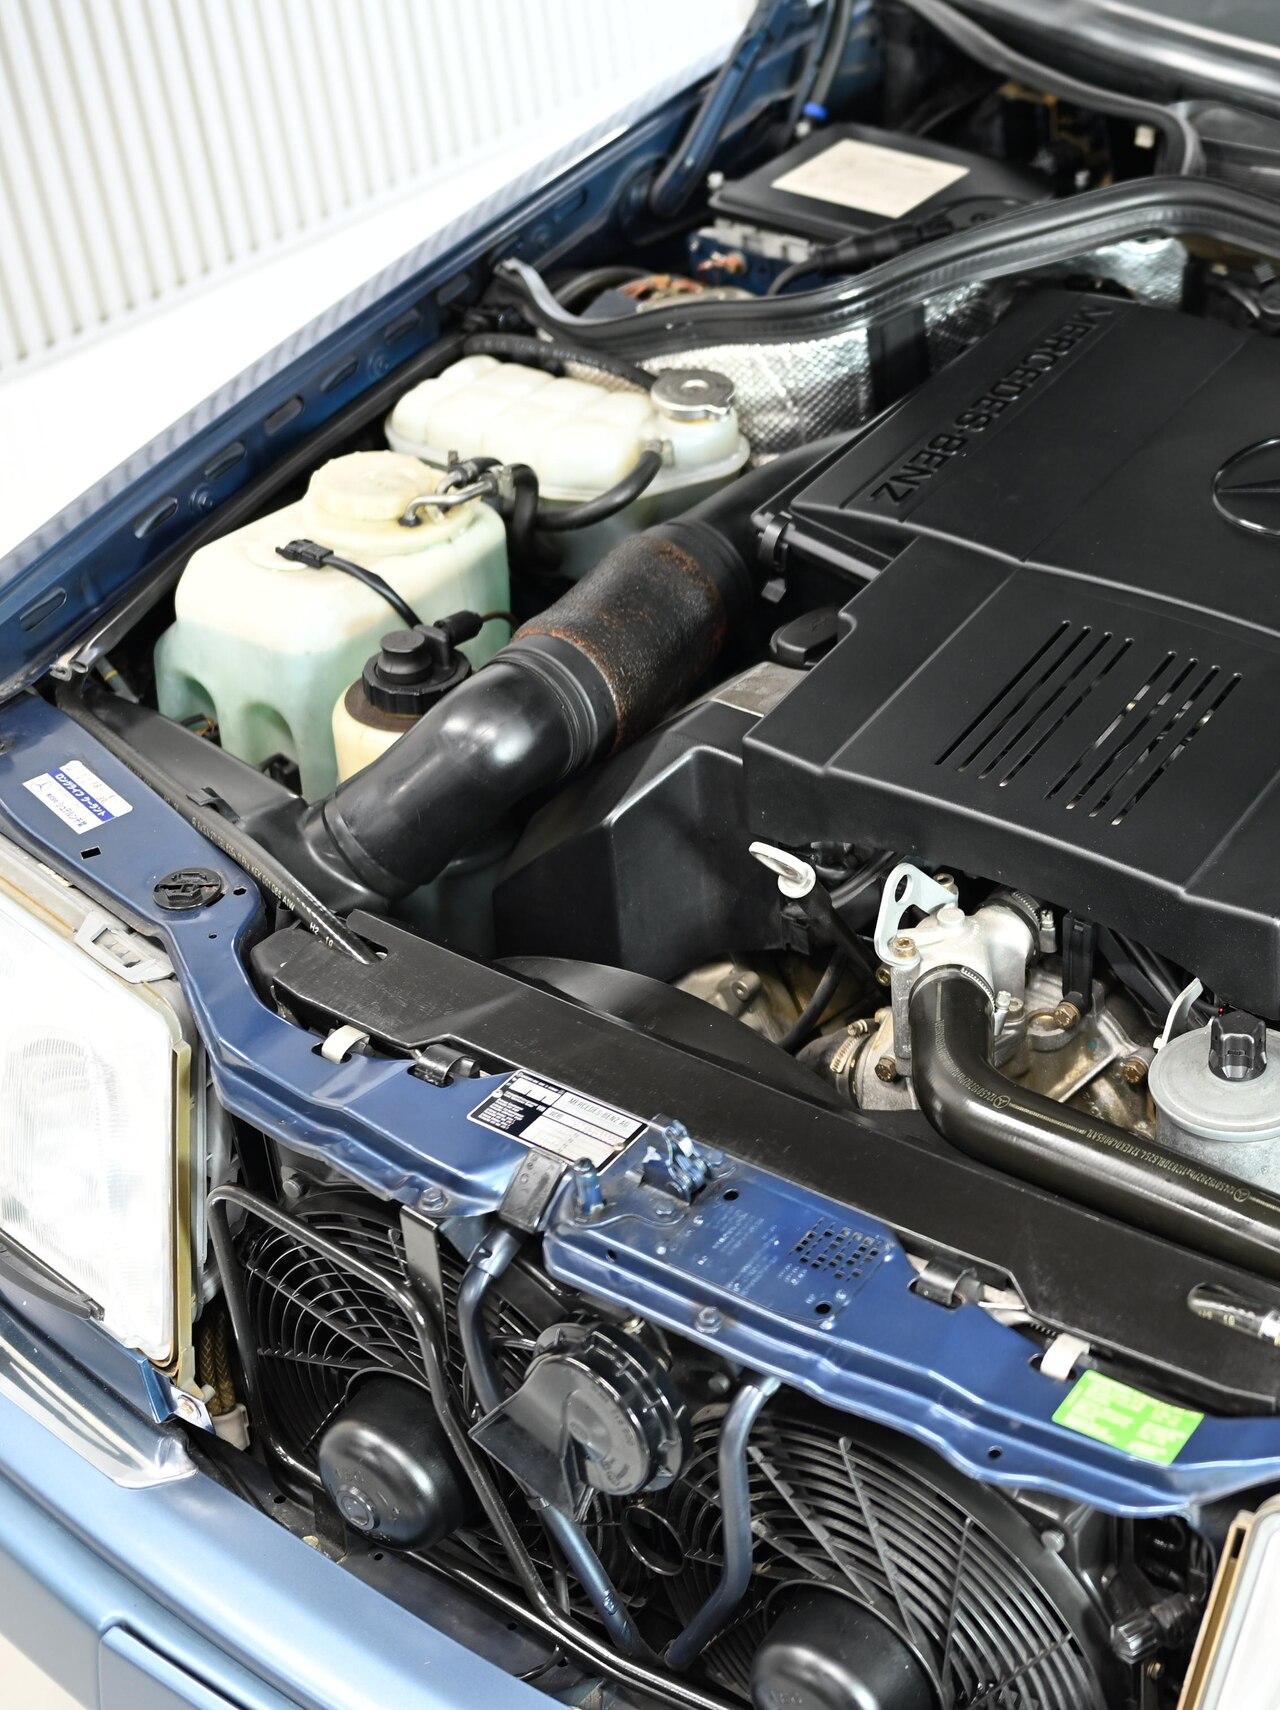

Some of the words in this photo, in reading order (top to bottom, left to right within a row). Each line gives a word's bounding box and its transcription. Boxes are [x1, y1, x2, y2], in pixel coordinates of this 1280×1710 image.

[869, 305, 1114, 505] MERCEDES-BENZ
[55, 773, 84, 797] ロングライフ
[80, 796, 106, 817] クーラント
[309, 922, 320, 935] H2
